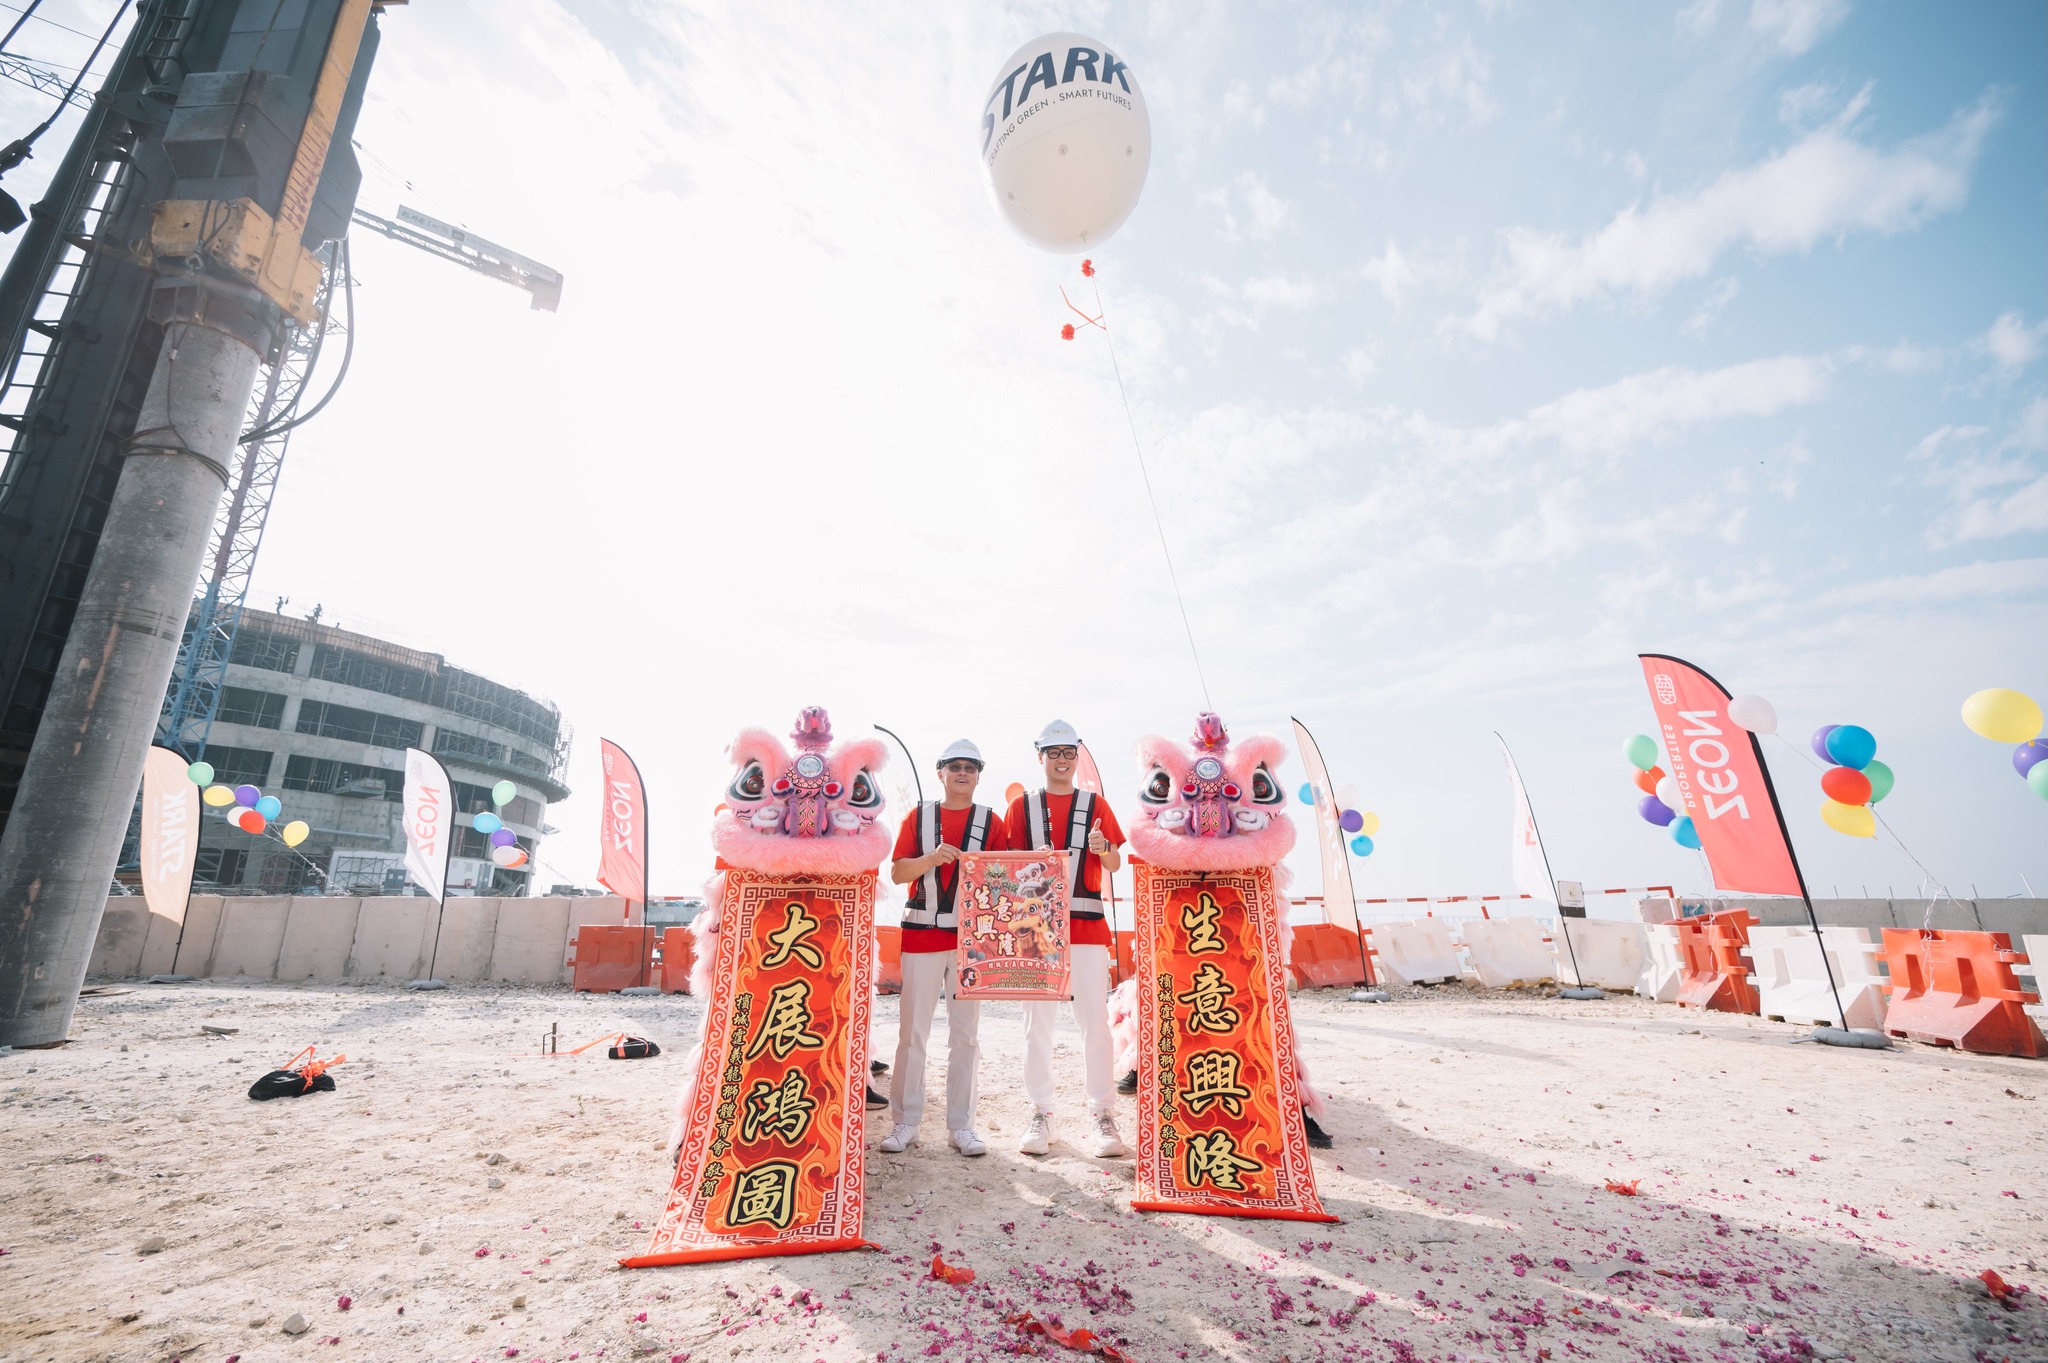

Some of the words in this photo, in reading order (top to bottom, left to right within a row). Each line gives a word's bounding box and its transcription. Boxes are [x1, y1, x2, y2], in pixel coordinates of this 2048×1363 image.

[982, 47, 1132, 162] STARK
[988, 123, 1016, 166] CRAFTING
[1016, 98, 1049, 125] GREEN
[1059, 89, 1093, 102] SMART
[1097, 90, 1132, 110] FUTURES
[725, 903, 825, 1228] 大展鴻圖
[1178, 892, 1262, 1190] 生意興隆
